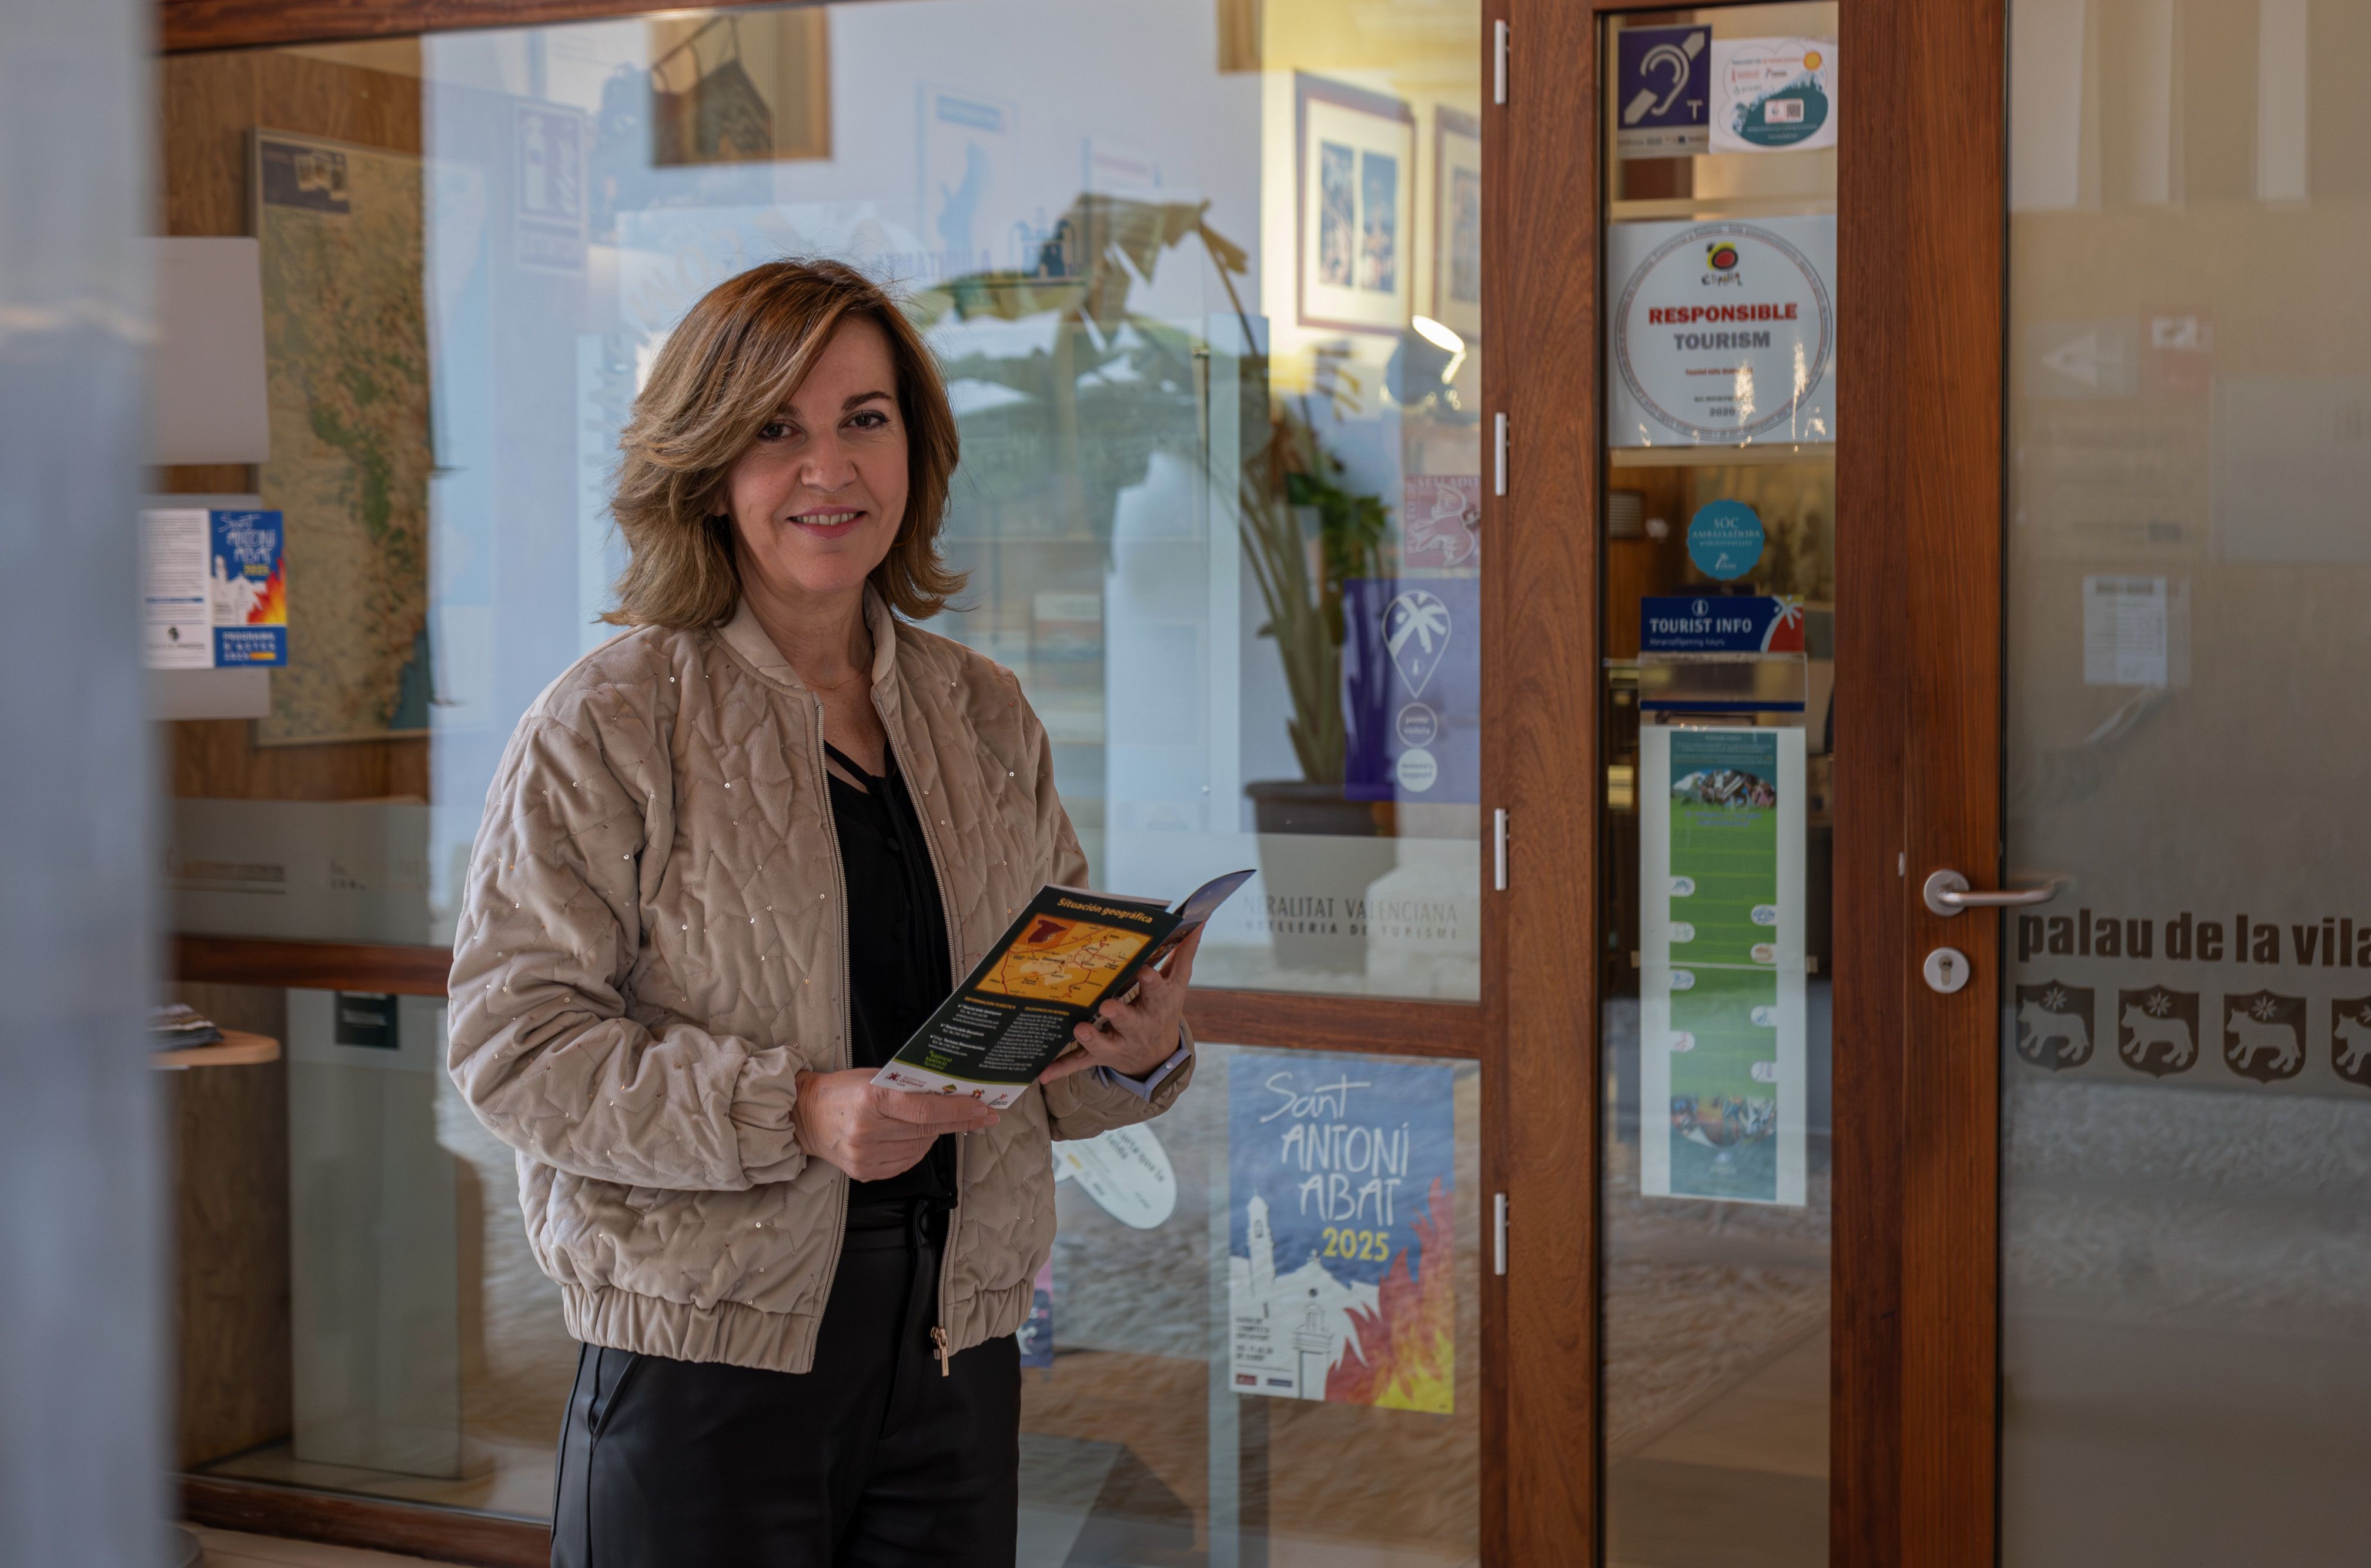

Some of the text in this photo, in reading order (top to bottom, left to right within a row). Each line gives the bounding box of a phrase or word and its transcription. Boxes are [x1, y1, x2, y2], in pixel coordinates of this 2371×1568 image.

[1648, 302, 1798, 325] RESPONSIBLE
[1674, 330, 1771, 351] TOURISM
[1649, 618, 1753, 634] TOURIST INFO
[1057, 897, 1153, 924] Situación geográfica
[2018, 908, 2153, 963] palau
[2165, 912, 2224, 961] de
[2236, 914, 2280, 965] la
[1259, 1071, 1372, 1124] Sant
[1298, 1173, 1403, 1227] ABAT
[1322, 1226, 1390, 1262] 2025
